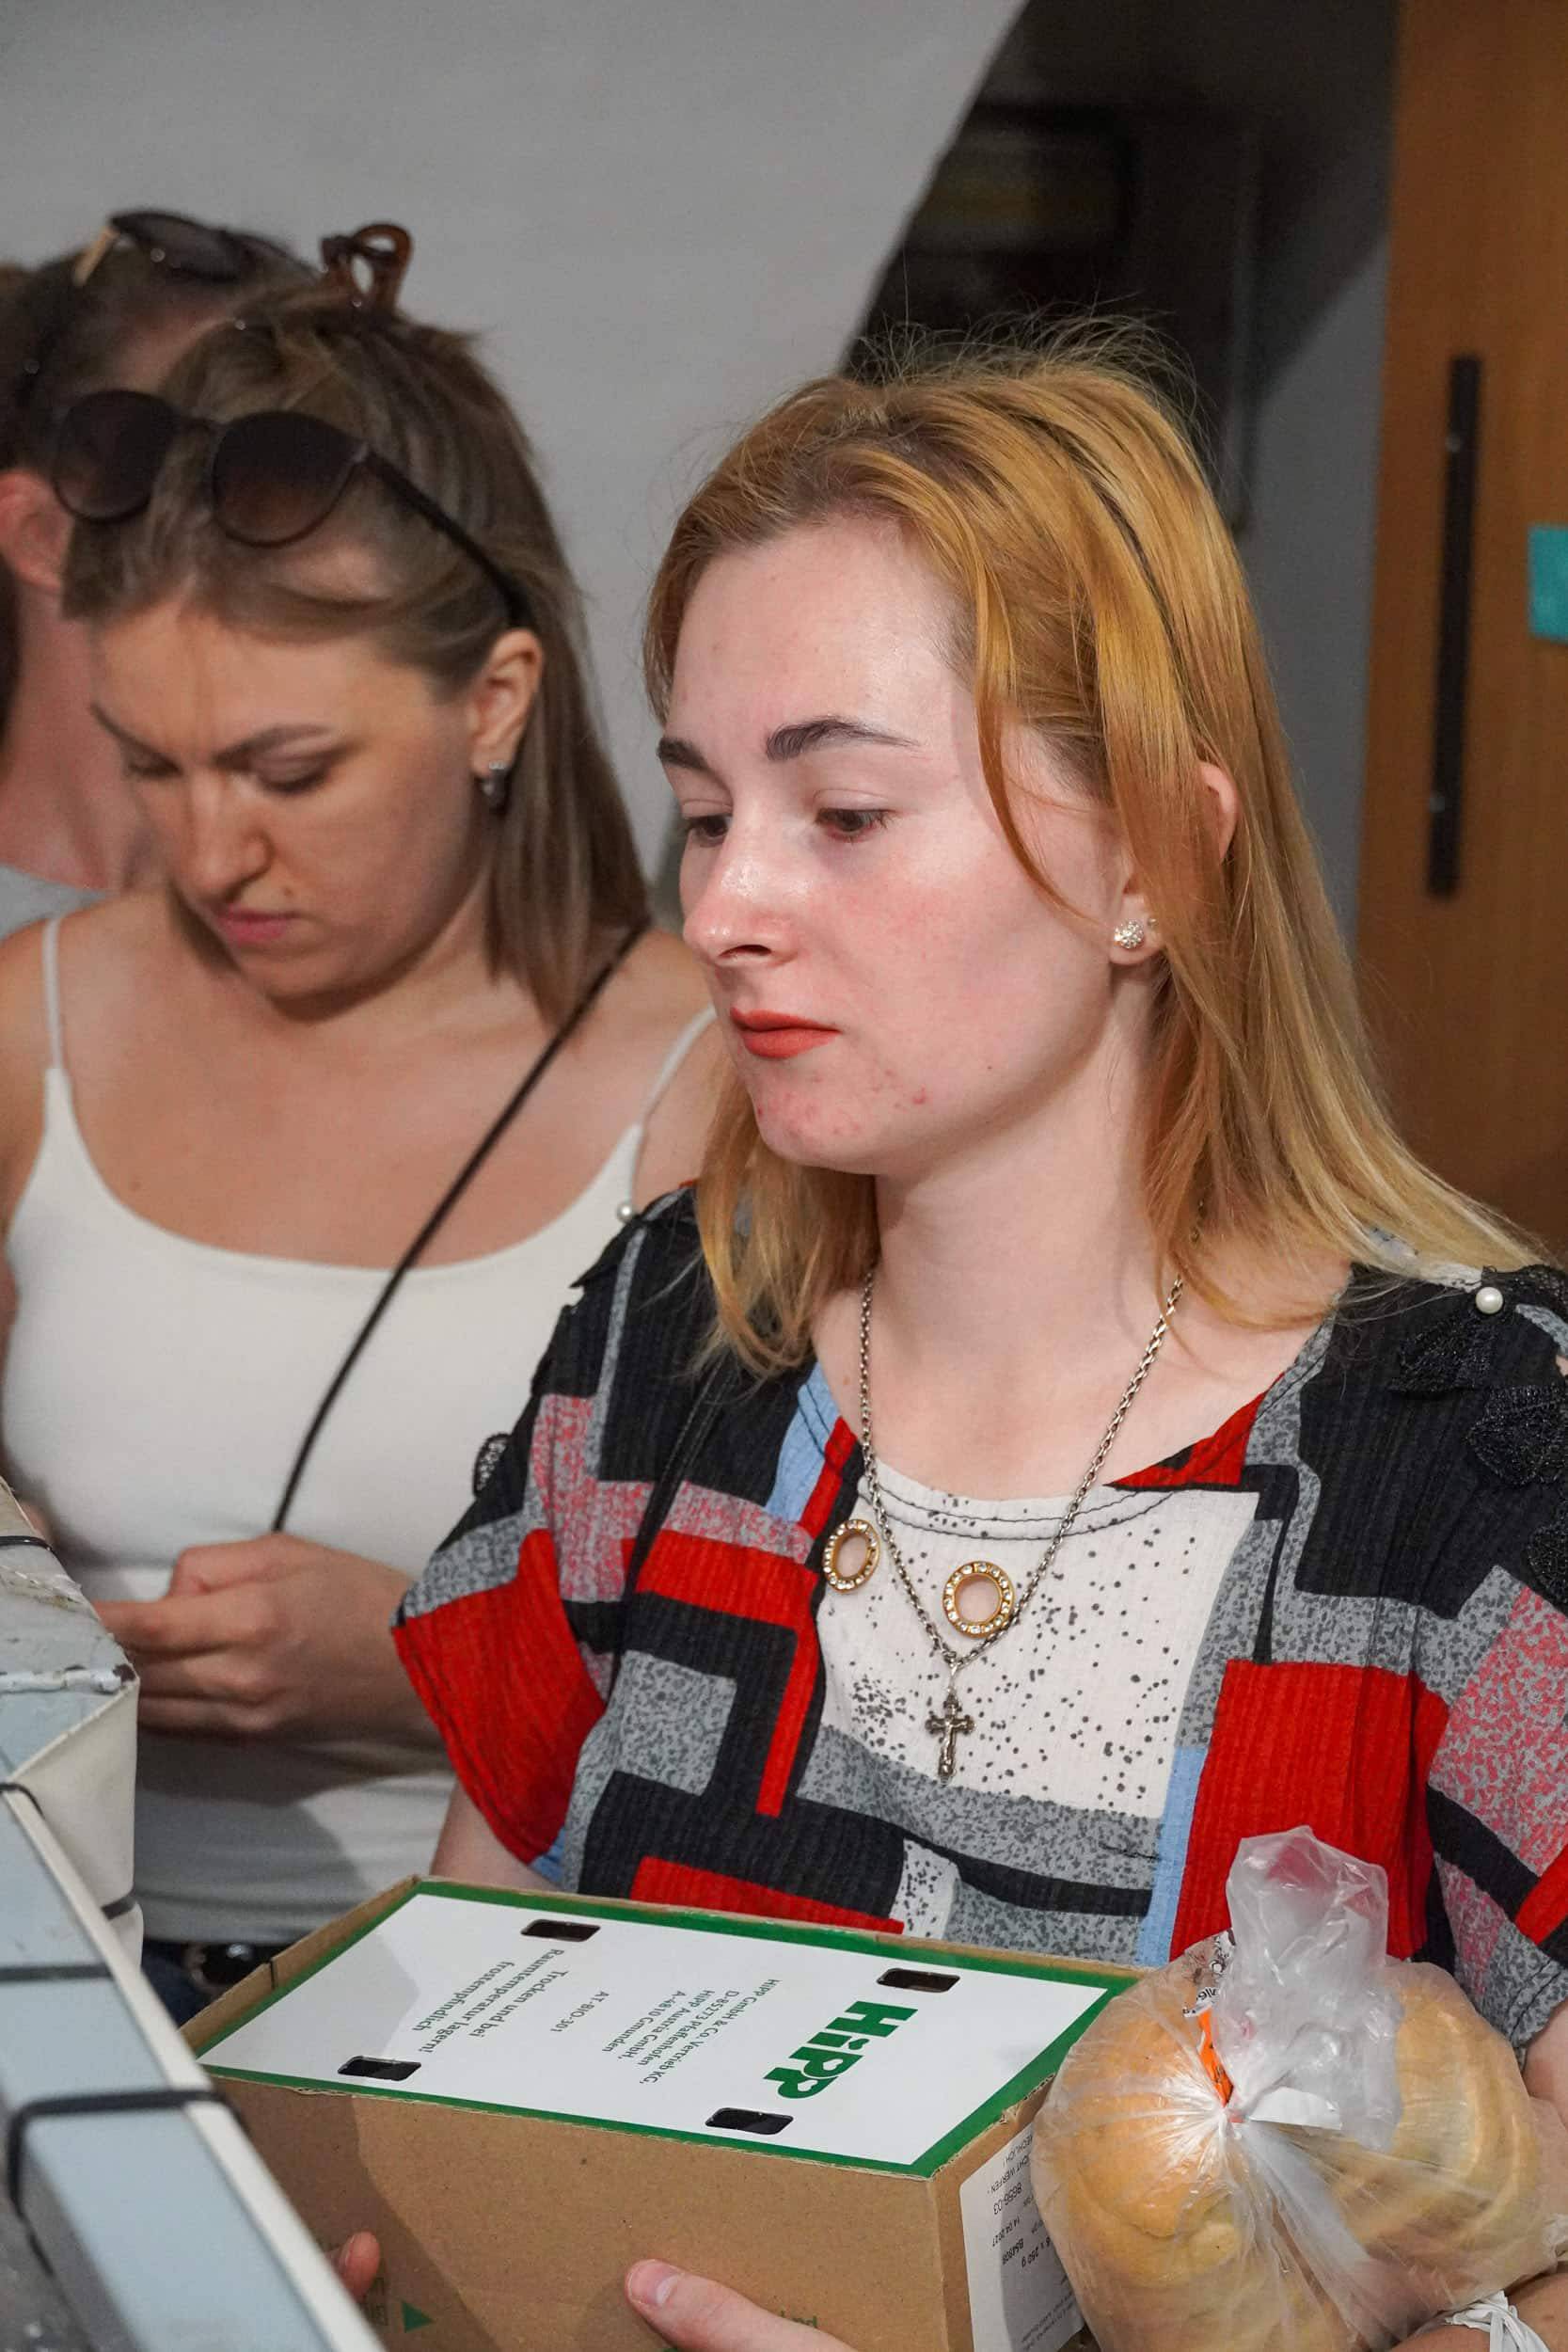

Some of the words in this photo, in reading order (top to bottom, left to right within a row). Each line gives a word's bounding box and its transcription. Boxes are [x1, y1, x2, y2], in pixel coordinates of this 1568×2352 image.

[412, 1961, 515, 2031] frostempfindlich
[462, 1948, 564, 2022] Raumtemperatur
[516, 1969, 569, 2003] Trocken
[753, 1979, 781, 1996] HiPP
[550, 1991, 610, 2032] AT-BIO-301
[648, 1990, 686, 2016] A-4810
[689, 1990, 715, 2008] HiPP
[696, 1990, 739, 2020] D-85273
[721, 1996, 757, 2020] GmbH
[489, 2004, 517, 2023] und
[652, 2007, 690, 2033] Austria
[418, 2021, 469, 2054] lagern!
[469, 2023, 499, 2038] bei
[602, 2017, 654, 2052] Gmunden
[638, 2021, 702, 2066] Pfaffenhofen
[696, 2027, 719, 2039] Co.
[618, 2034, 657, 2059] GmbH,
[659, 2041, 704, 2070] Vertrieb
[763, 2001, 918, 2099] HiPP
[640, 2071, 665, 2084] KG,
